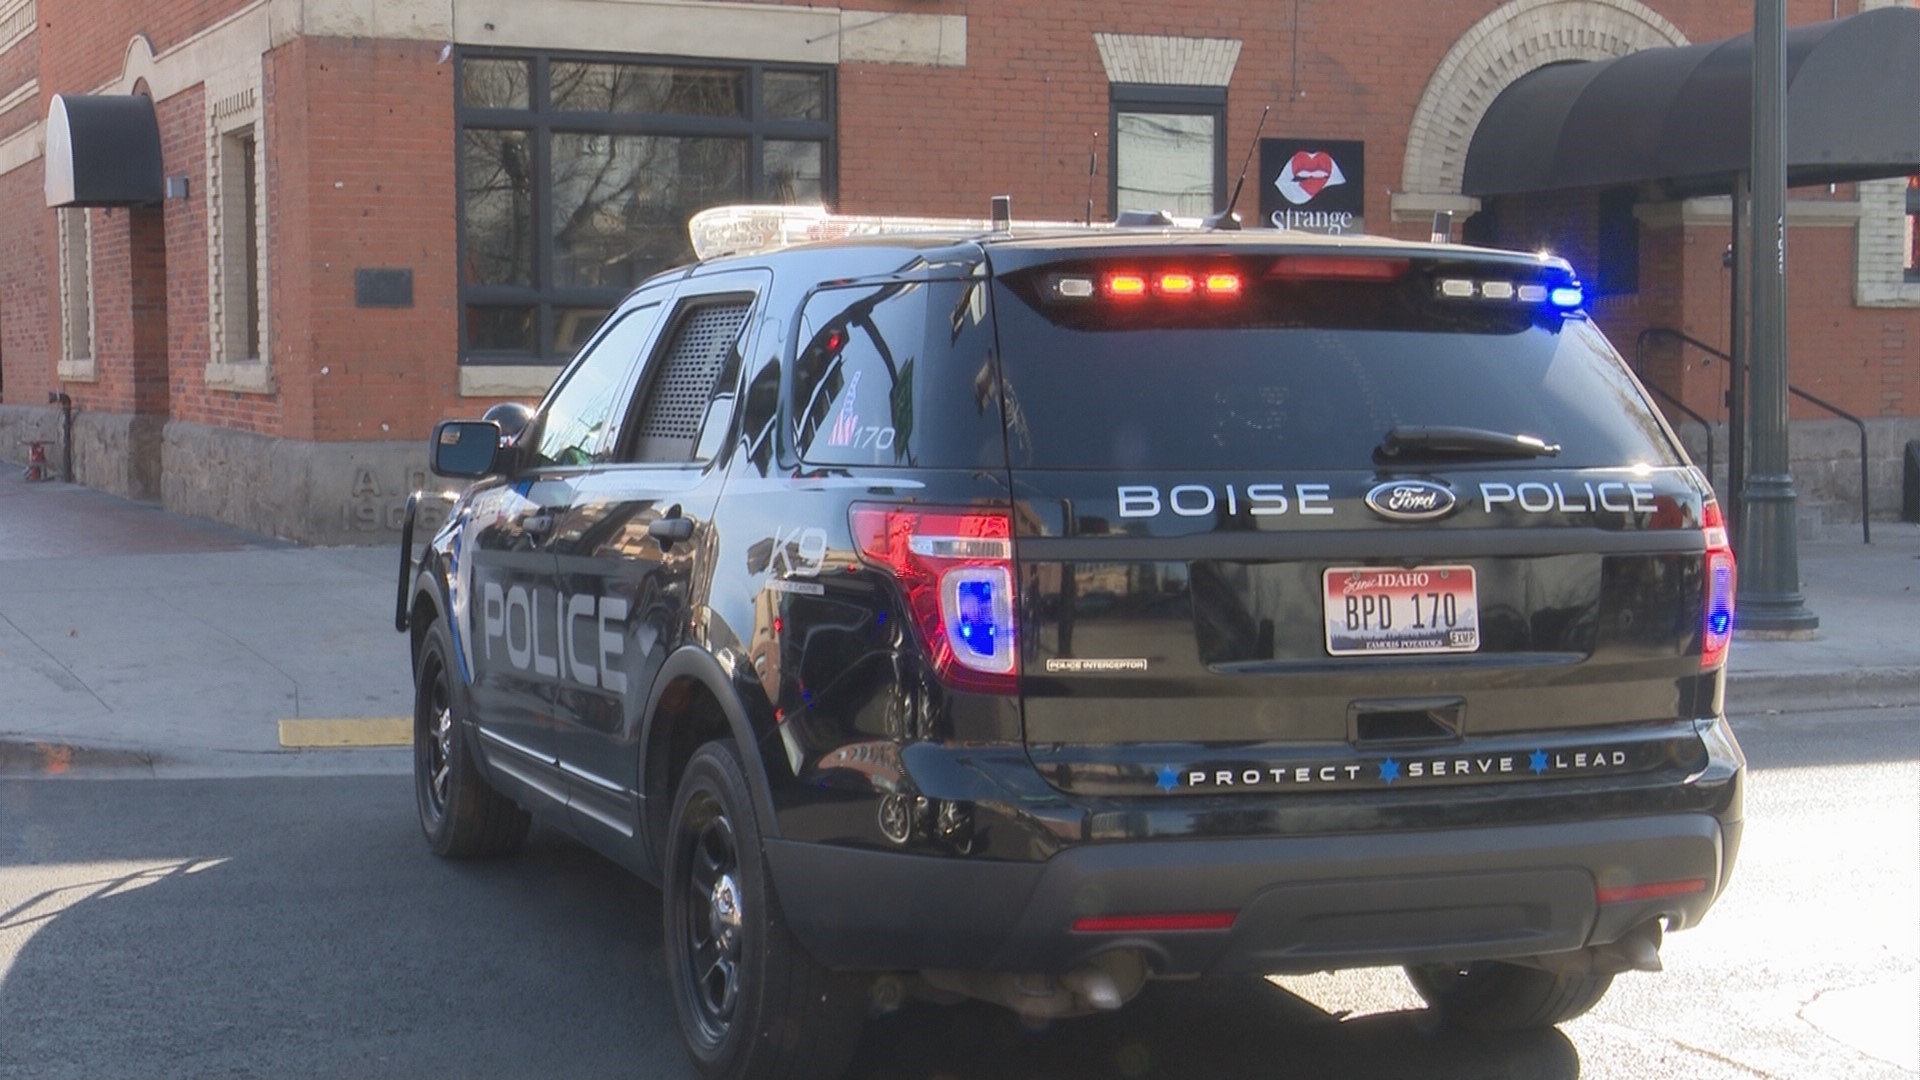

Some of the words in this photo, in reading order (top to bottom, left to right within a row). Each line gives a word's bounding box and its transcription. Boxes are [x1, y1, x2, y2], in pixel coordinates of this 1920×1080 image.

[1271, 208, 1353, 235] strange
[853, 427, 896, 450] 170
[1117, 484, 1335, 518] BOISE
[1388, 486, 1437, 510] Ford
[1478, 482, 1659, 513] POLICE
[768, 525, 828, 578] K9
[1343, 576, 1377, 594] Scenic
[1377, 572, 1429, 588] IDAHO
[1345, 593, 1392, 632] BPD
[1410, 592, 1457, 629] 170
[483, 581, 628, 695] POLICE
[1366, 640, 1400, 650] FAMOUS
[1400, 639, 1443, 649] POTATOES
[1049, 660, 1081, 670] POLICE
[1188, 765, 1361, 787] PROTECT
[1408, 757, 1513, 777] SERVE
[1556, 751, 1626, 769] LEAD
